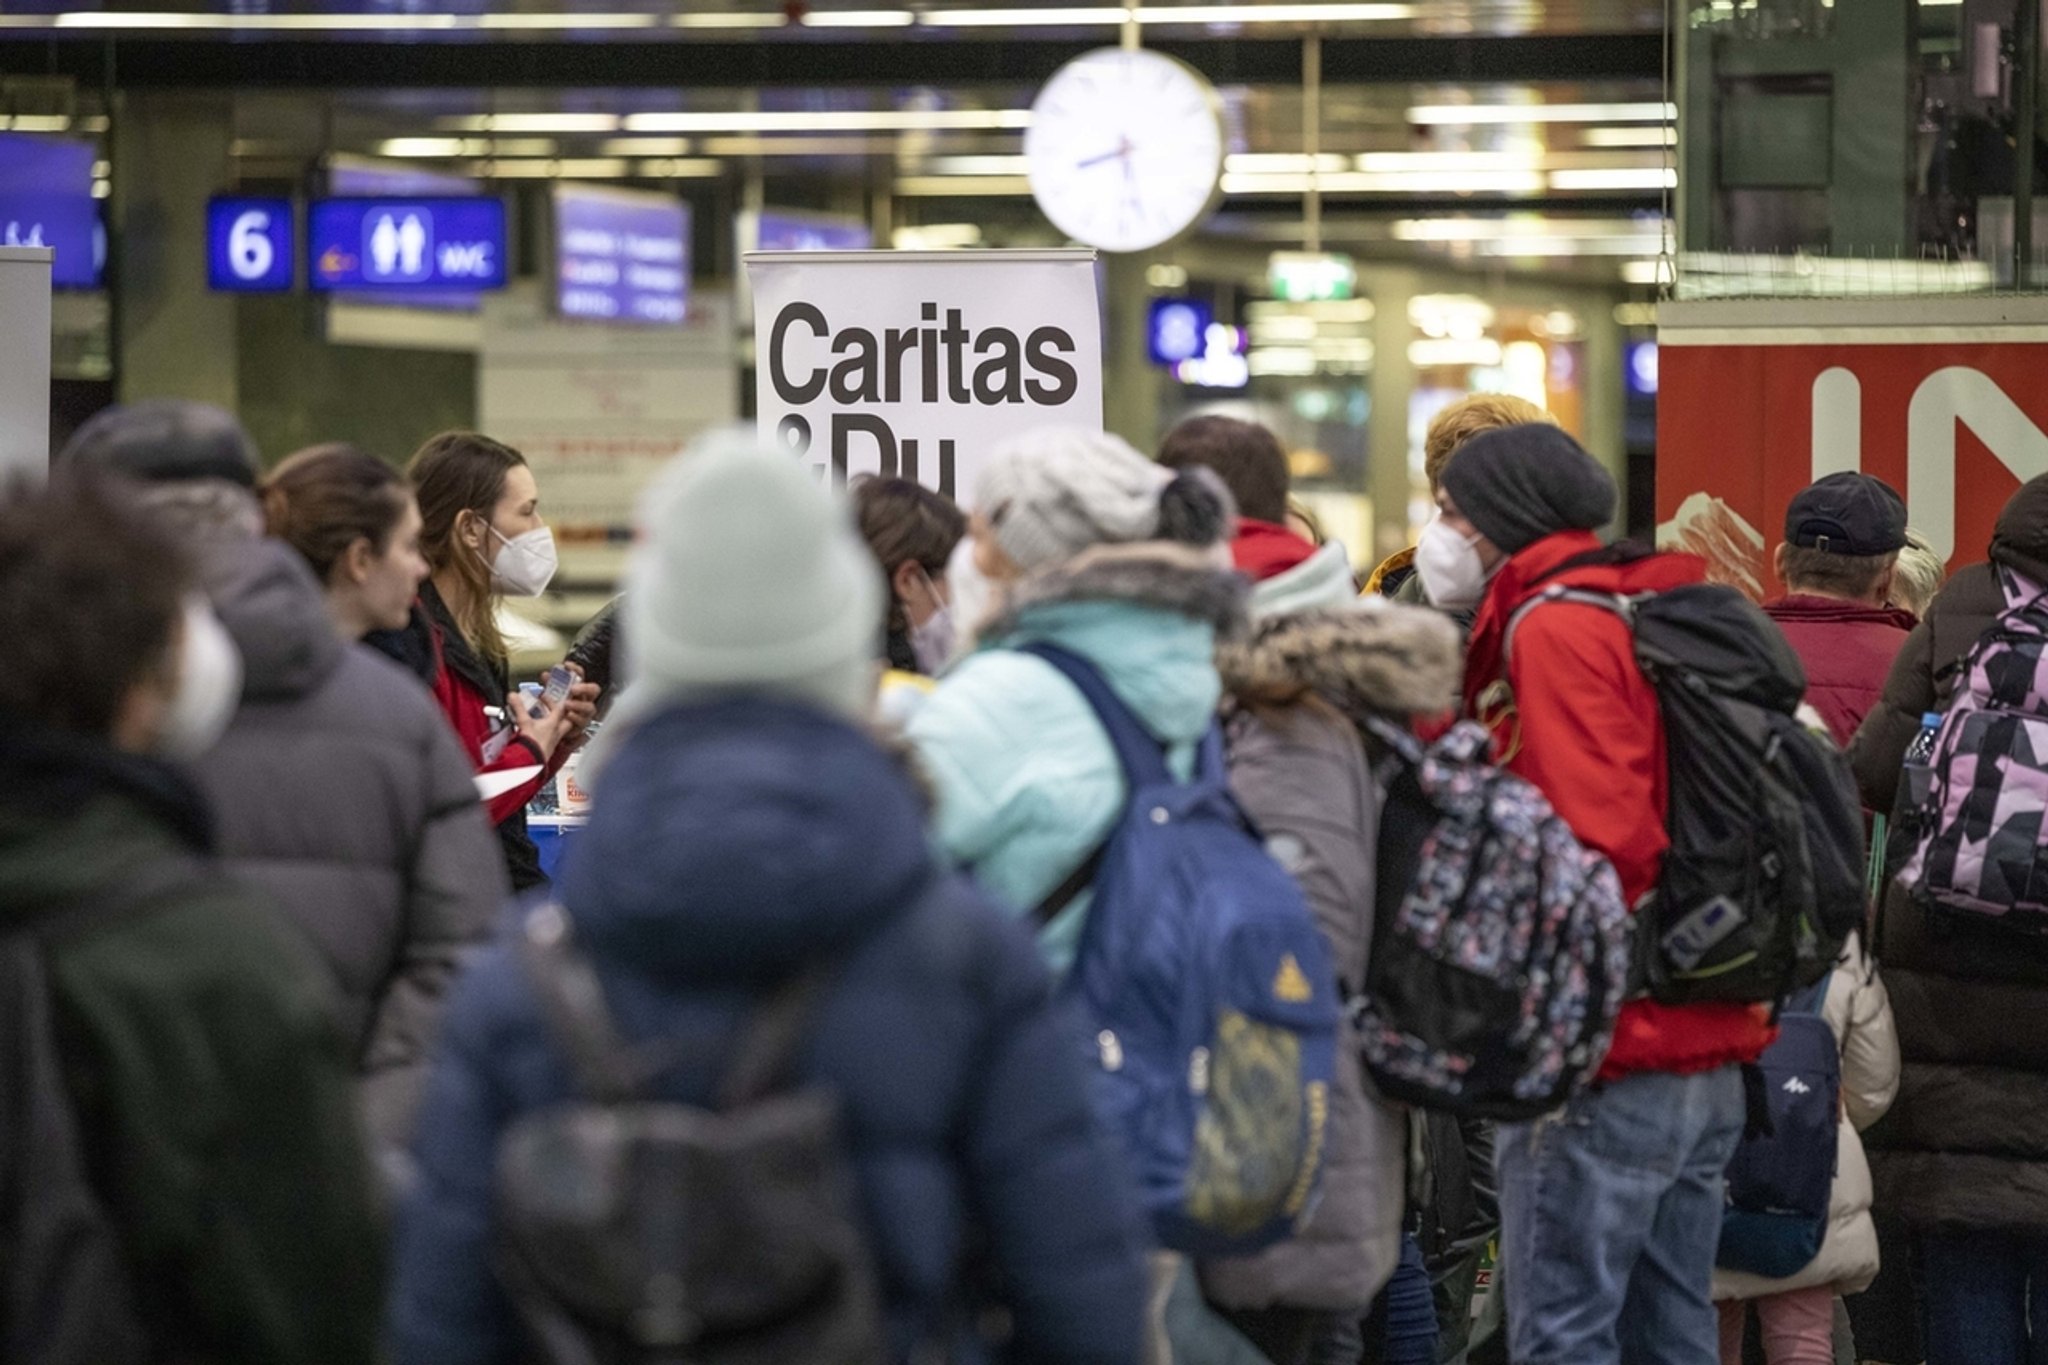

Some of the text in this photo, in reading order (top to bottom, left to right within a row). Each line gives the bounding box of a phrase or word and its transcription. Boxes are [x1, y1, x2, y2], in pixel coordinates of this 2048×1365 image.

[229, 210, 272, 279] 6
[437, 241, 495, 277] WC
[769, 301, 1078, 405] Caritas
[832, 413, 955, 502] Du
